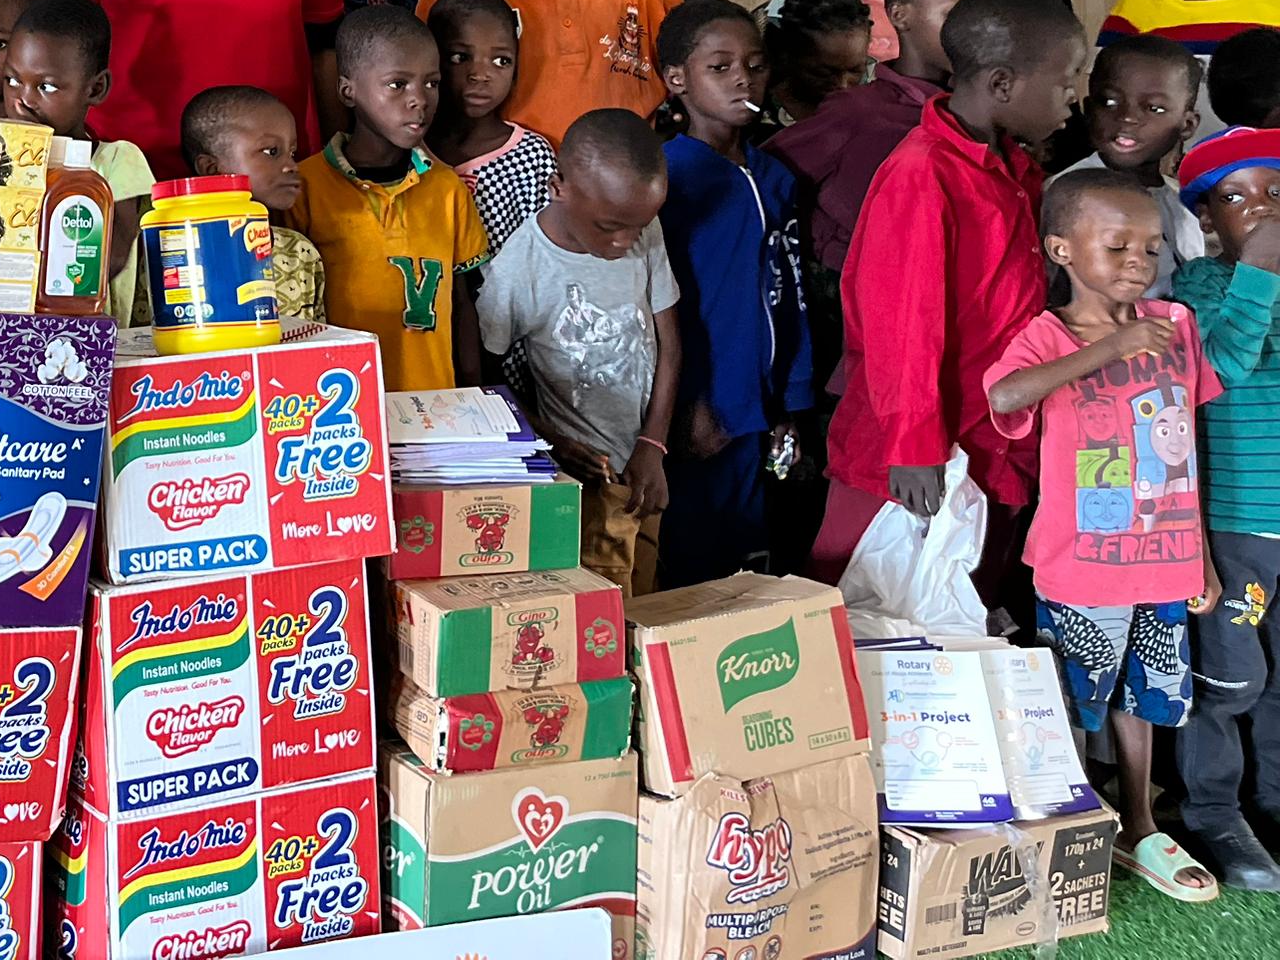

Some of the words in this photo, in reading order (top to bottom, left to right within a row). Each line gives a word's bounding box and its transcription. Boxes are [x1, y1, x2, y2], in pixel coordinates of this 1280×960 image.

[63, 216, 92, 229] Dettol
[387, 256, 443, 331] V
[23, 384, 65, 397] COTTON
[66, 386, 94, 398] FEEL
[117, 371, 244, 424] Indomie
[316, 371, 358, 427] 2
[269, 416, 302, 429] packs
[312, 425, 356, 444] packs
[144, 436, 180, 450] Instant
[183, 431, 226, 447] Noodles
[277, 440, 368, 478] Free
[43, 467, 65, 480] Pad
[151, 475, 248, 506] Chicken
[307, 477, 354, 495] Inside
[172, 504, 216, 520] Flavor
[282, 523, 321, 540] More
[129, 548, 193, 573] SUPER
[199, 539, 259, 567] PACK
[117, 594, 237, 652] Indomie
[307, 589, 348, 647] 2
[518, 610, 546, 622] Gino
[262, 637, 295, 652] packs
[304, 643, 345, 663] packs
[142, 664, 178, 680] Instant
[180, 656, 222, 674] Noodles
[721, 651, 796, 683] Knorr
[897, 660, 930, 670] Rotary
[3, 660, 55, 718] 2
[271, 658, 356, 700] Free
[149, 697, 243, 733] Chicken
[296, 694, 342, 715] Inside
[1024, 706, 1054, 722] Project
[880, 710, 917, 722] 3-in-1
[921, 711, 971, 725] Project
[170, 728, 212, 746] Flavor
[744, 716, 794, 752] CUBES
[272, 741, 309, 759] More
[128, 776, 188, 804] SUPER
[194, 761, 250, 790] PACK
[720, 788, 746, 802] KILLS
[124, 819, 247, 879] Indomie
[316, 810, 356, 869] 2
[709, 814, 791, 883] hypo
[1065, 843, 1083, 857] 170g
[1092, 837, 1104, 850] 24
[270, 859, 302, 876] packs
[311, 865, 354, 886] packs
[468, 842, 598, 909] Power
[148, 889, 184, 906] Instant
[187, 880, 228, 899] Noodles
[1051, 872, 1064, 896] 2
[1064, 872, 1106, 895] SACHETS
[278, 880, 365, 926] Free
[516, 880, 552, 914] Oil
[155, 922, 246, 960] Chicken
[304, 917, 351, 941] Inside
[728, 920, 771, 939] BLEACH
[850, 949, 865, 959] Look
